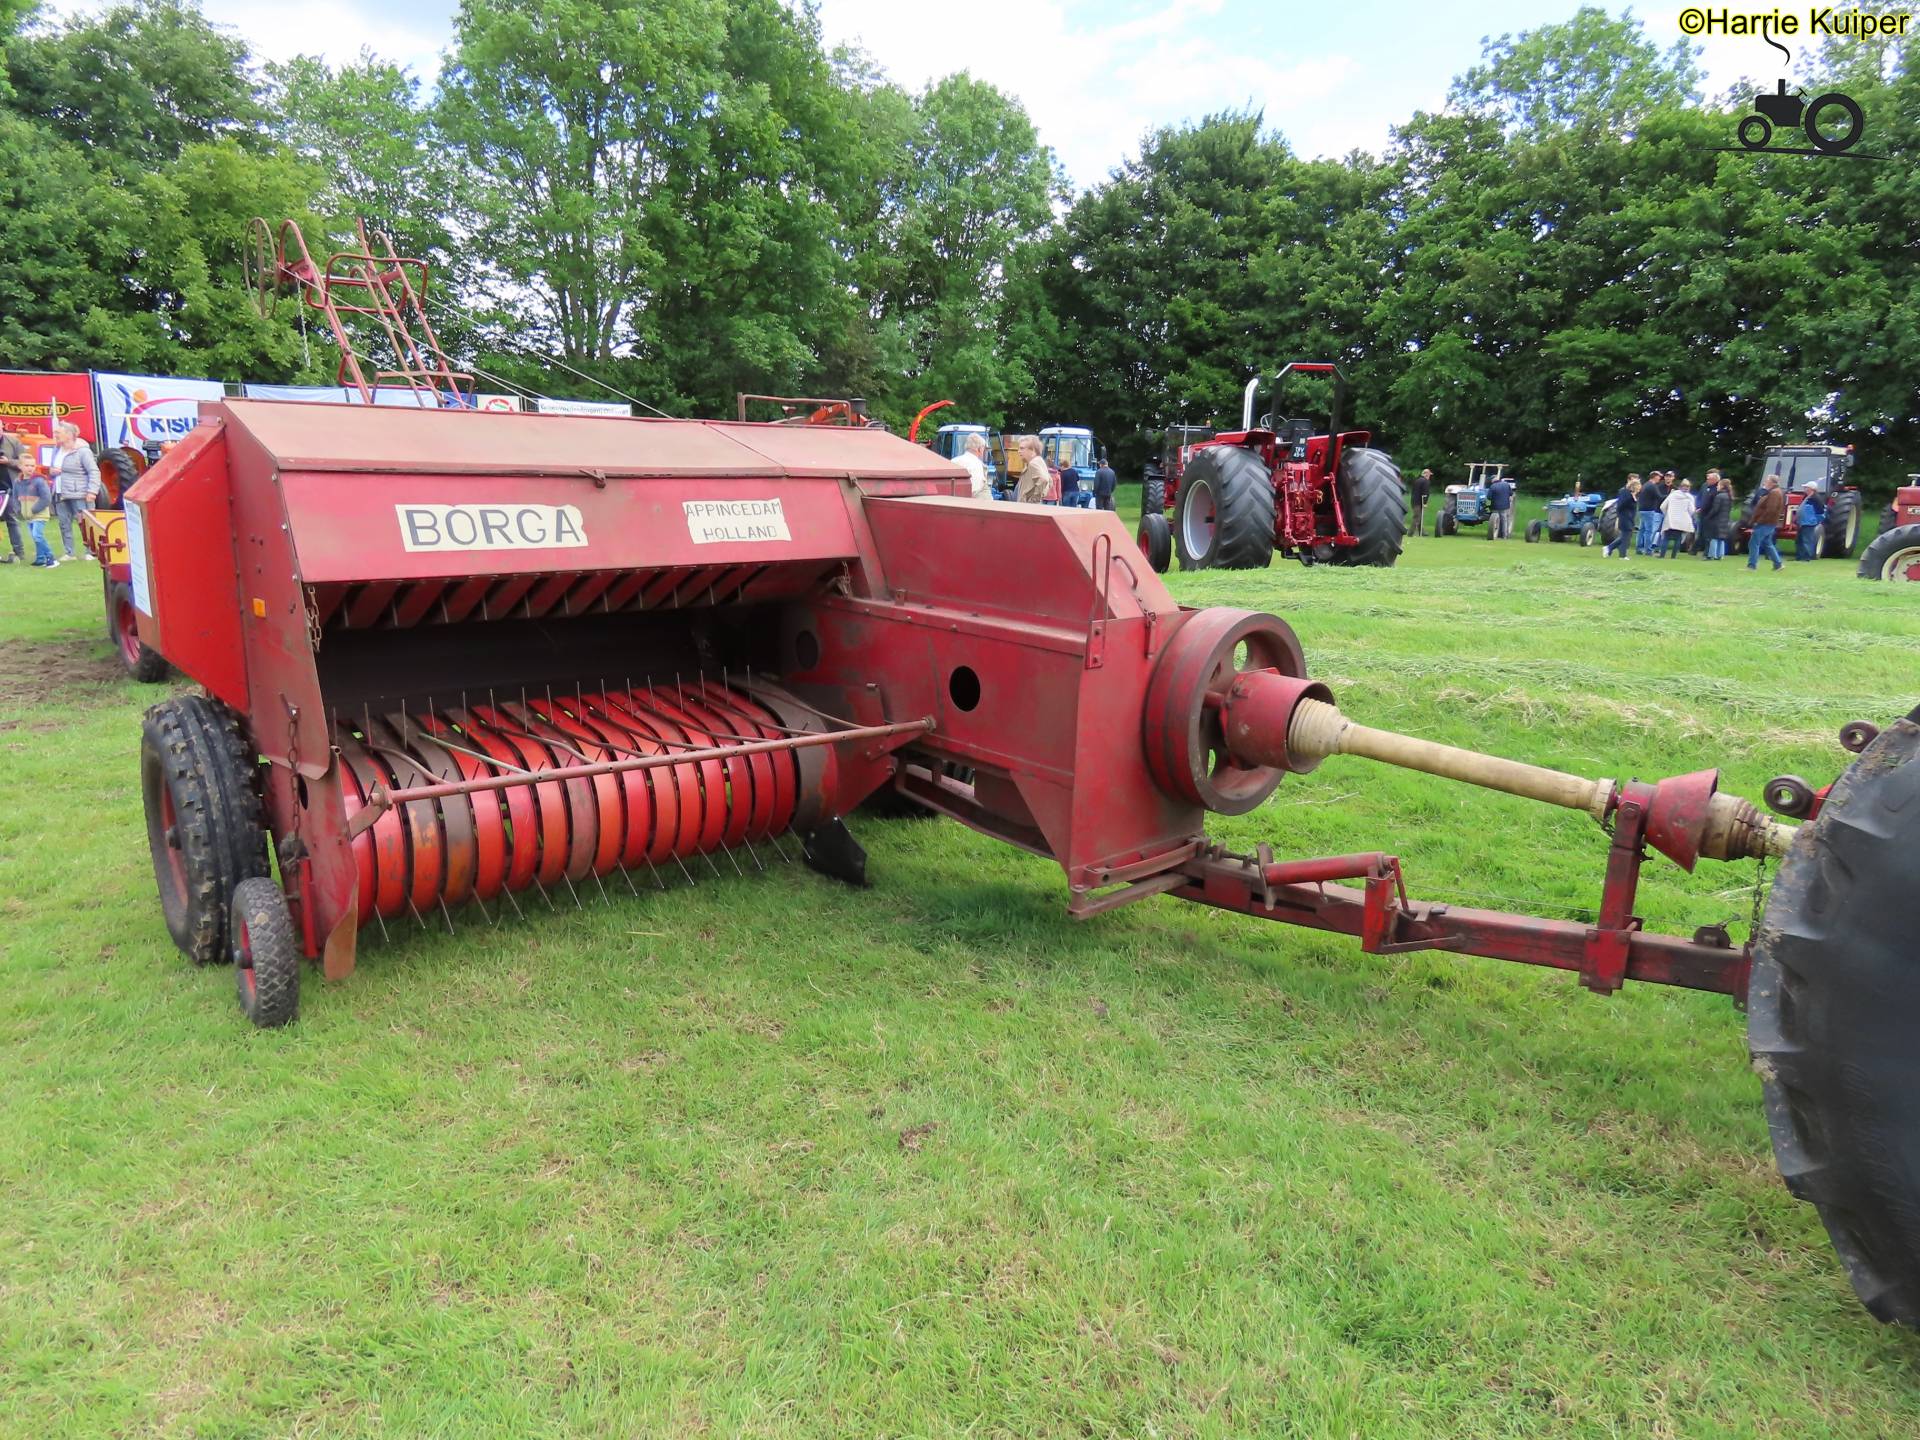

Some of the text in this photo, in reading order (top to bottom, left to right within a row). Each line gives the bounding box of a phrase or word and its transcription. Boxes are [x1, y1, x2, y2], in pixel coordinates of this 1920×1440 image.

[686, 502, 782, 517] APPINGEDAM
[405, 508, 581, 546] BORGA
[702, 525, 777, 540] HOLLAND
